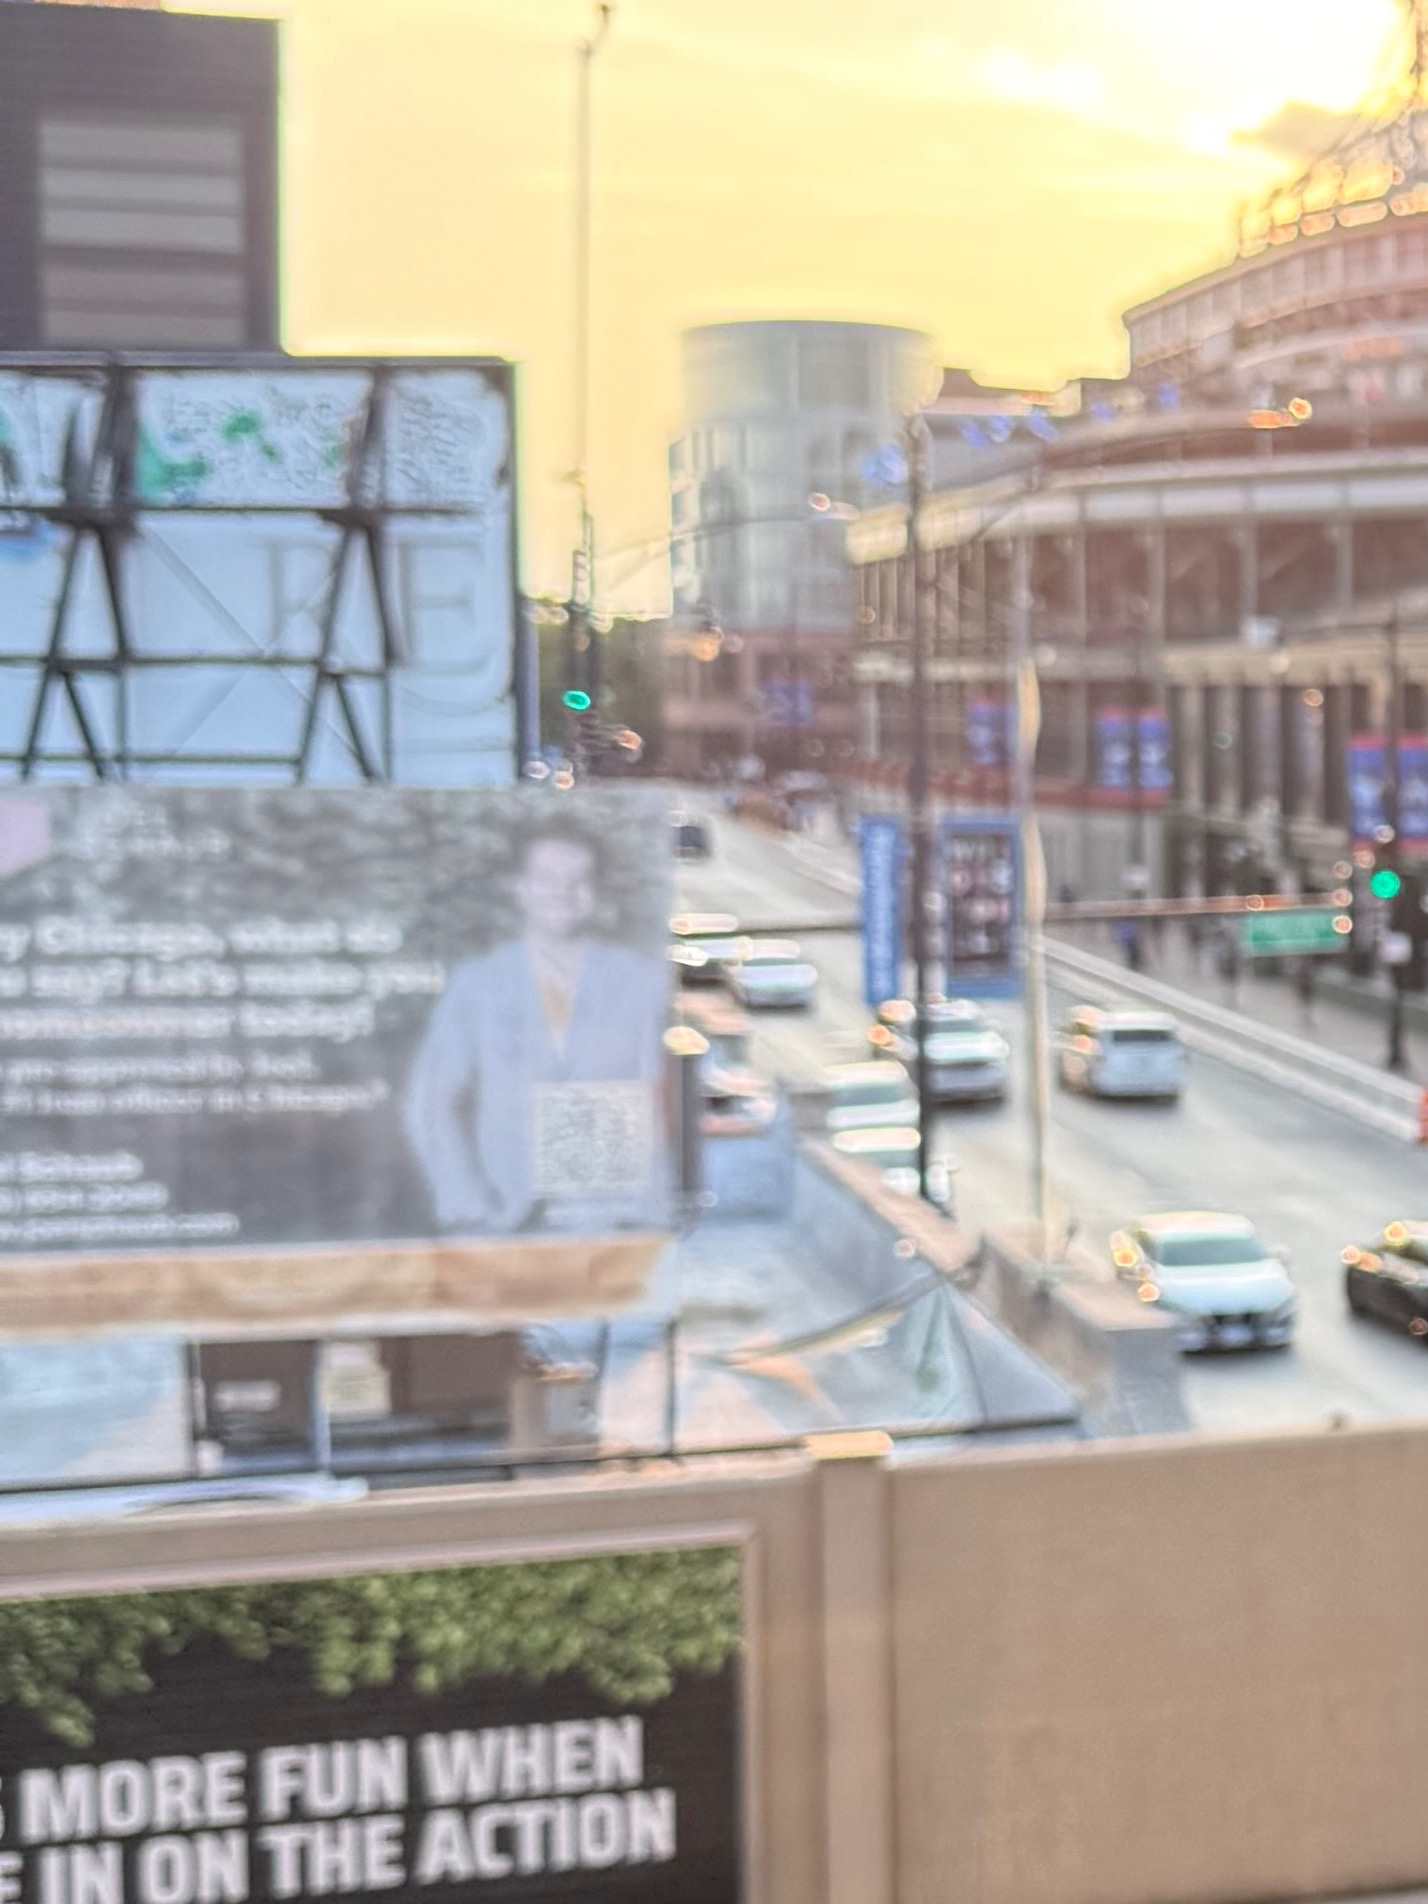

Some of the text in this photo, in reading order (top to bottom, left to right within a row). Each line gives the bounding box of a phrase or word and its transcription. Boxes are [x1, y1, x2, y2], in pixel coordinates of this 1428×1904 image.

[20, 1715, 643, 1843] MORE FUN WHEN
[257, 1813, 407, 1899] THE
[413, 1787, 678, 1886] ACTION
